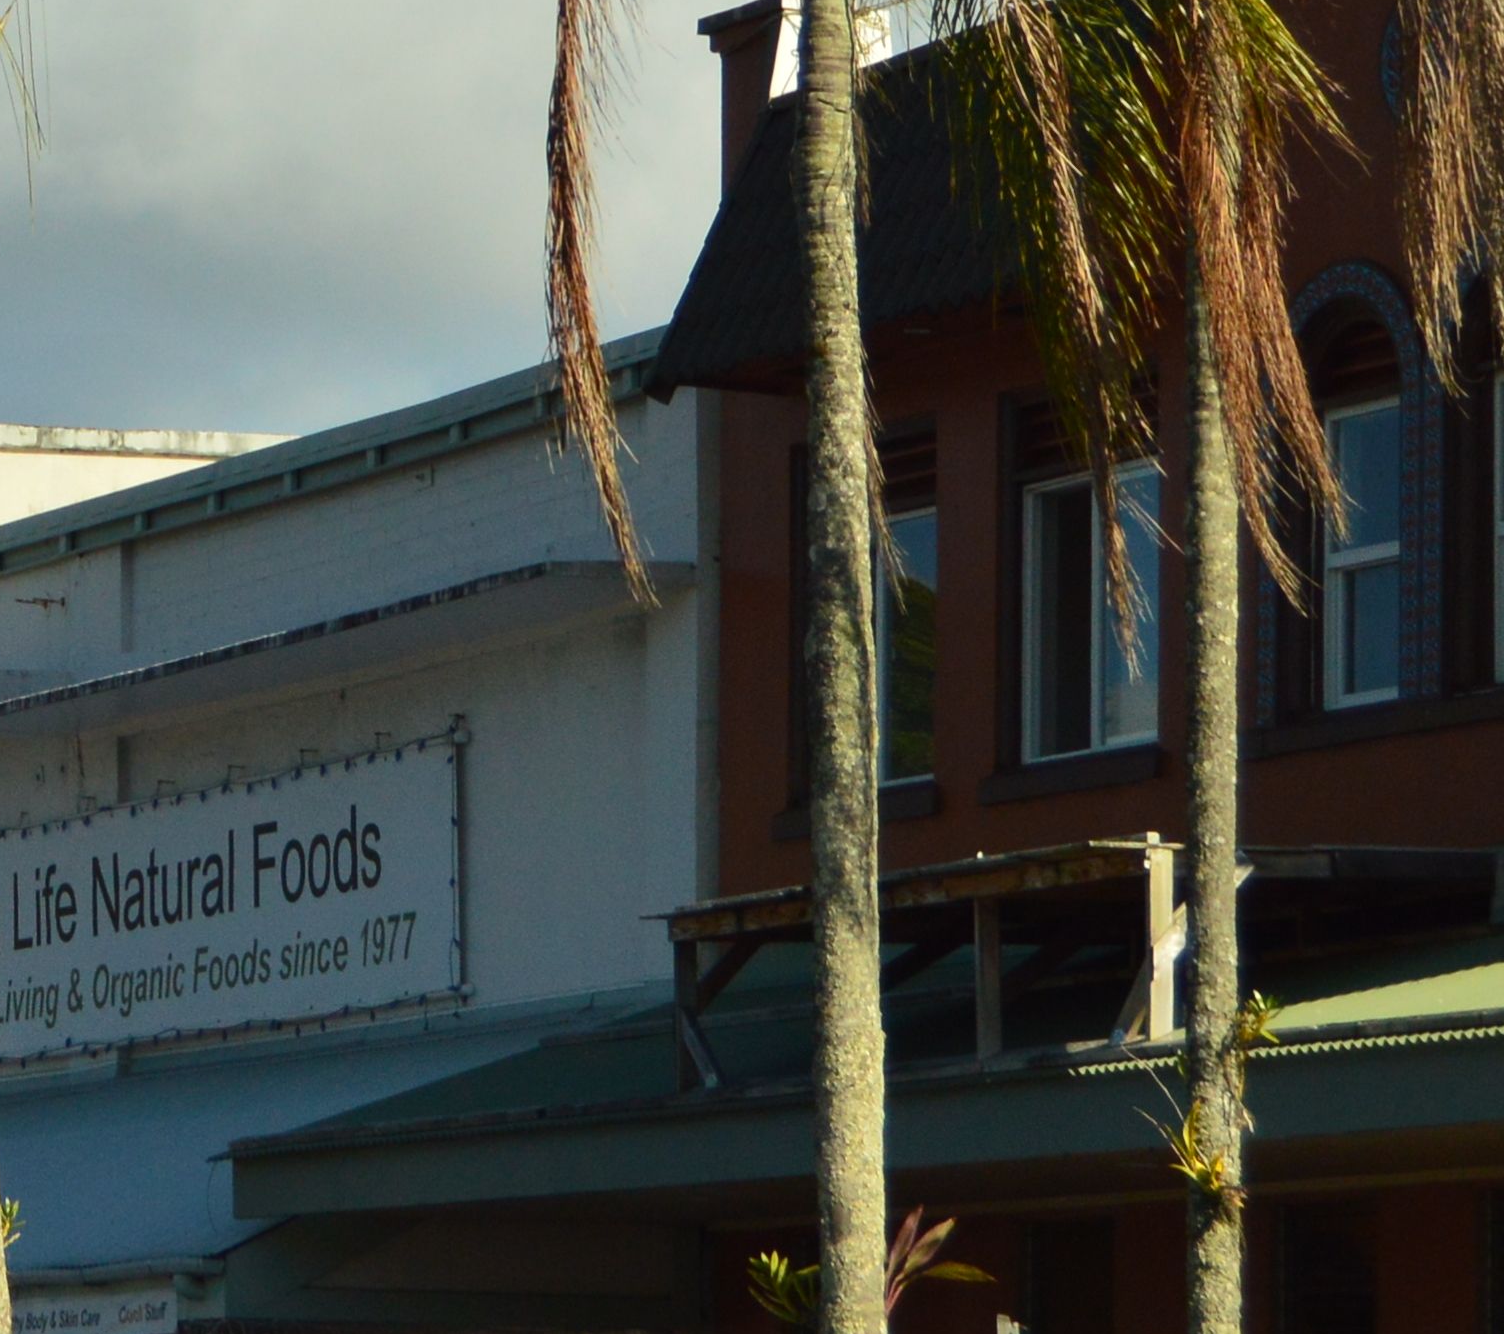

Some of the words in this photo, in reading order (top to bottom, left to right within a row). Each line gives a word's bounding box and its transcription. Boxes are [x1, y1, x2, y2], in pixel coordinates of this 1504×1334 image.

[13, 863, 78, 951] Life
[92, 829, 235, 937] Natural
[252, 804, 382, 908] Foods
[67, 968, 83, 1014] &
[93, 953, 186, 1018] Organic
[193, 938, 272, 994] Foods
[279, 930, 348, 980] since
[360, 911, 417, 967] 1977
[25, 1313, 49, 1333] Body
[59, 1310, 79, 1328] Skin
[80, 1309, 101, 1326] Care
[118, 1305, 143, 1323] Cool
[144, 1301, 168, 1321] Stuff
